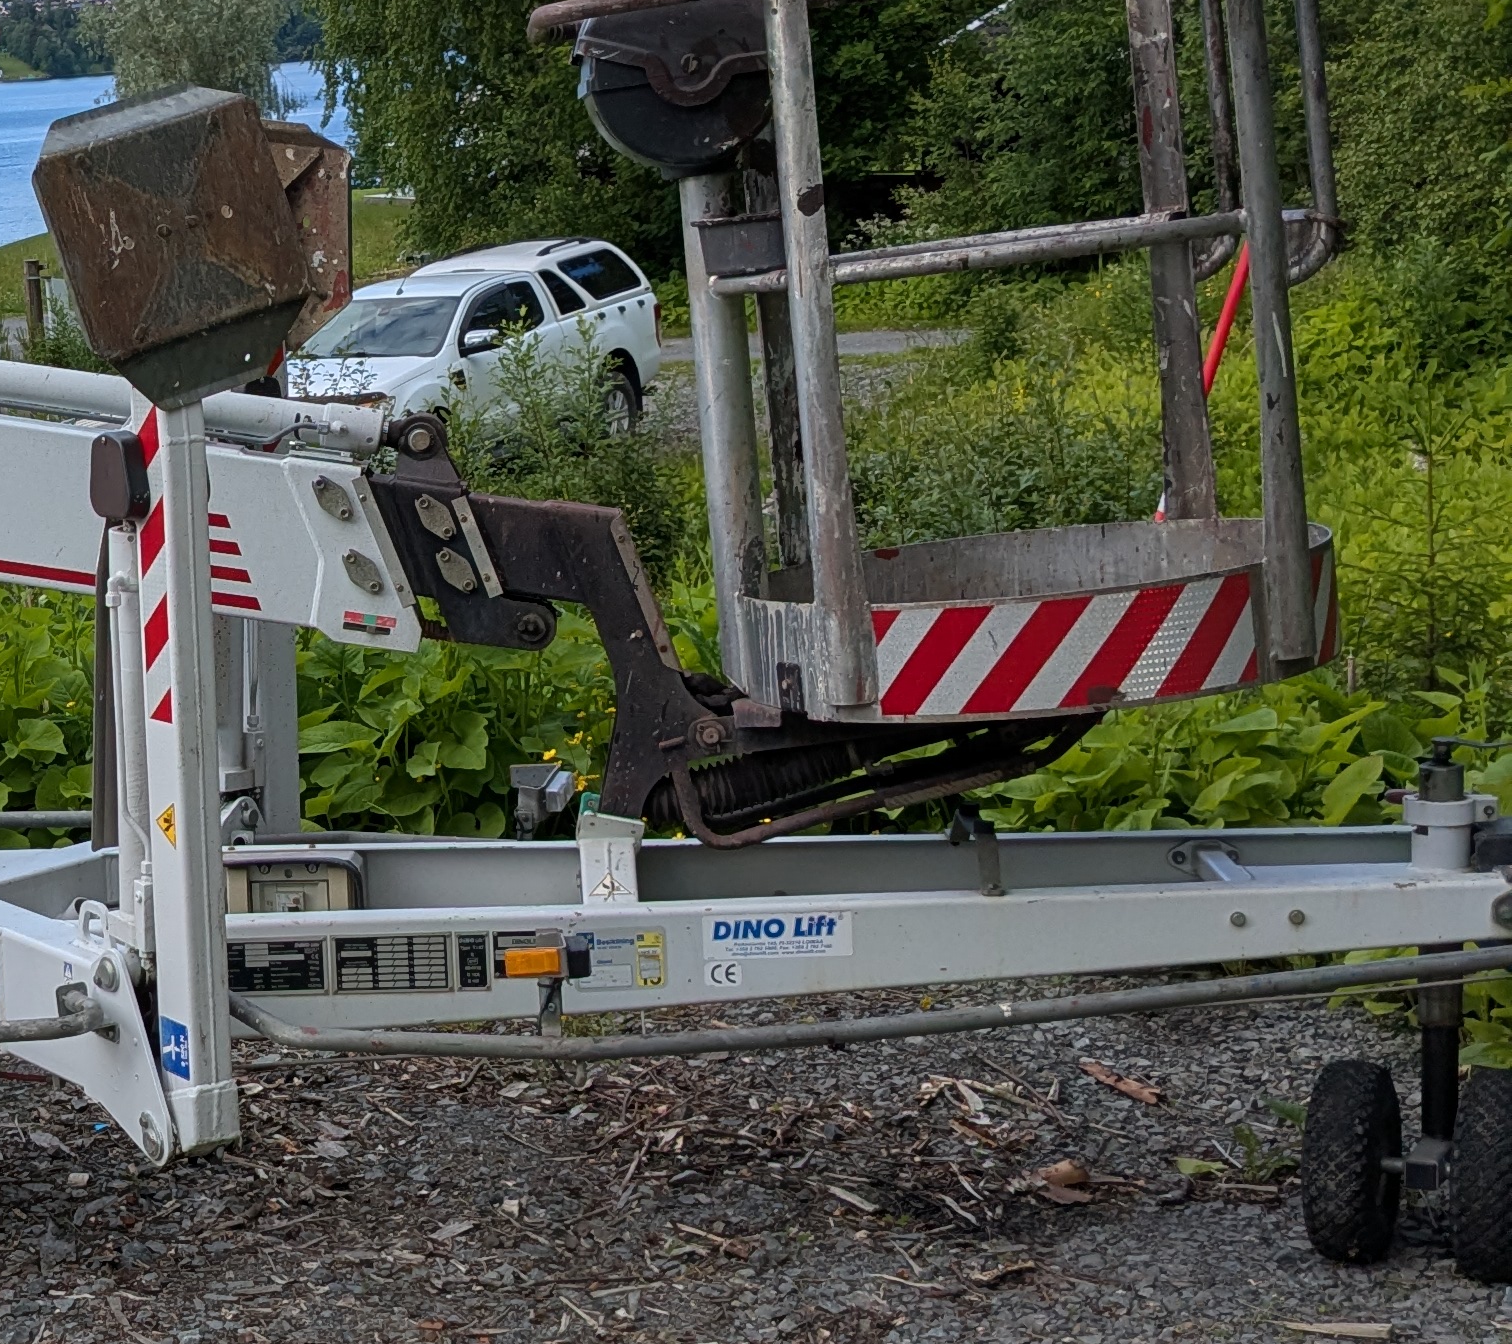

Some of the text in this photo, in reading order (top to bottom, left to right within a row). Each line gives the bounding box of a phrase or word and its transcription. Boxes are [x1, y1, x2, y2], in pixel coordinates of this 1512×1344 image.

[711, 914, 837, 941] DINO Lift
[710, 963, 737, 985] CE
